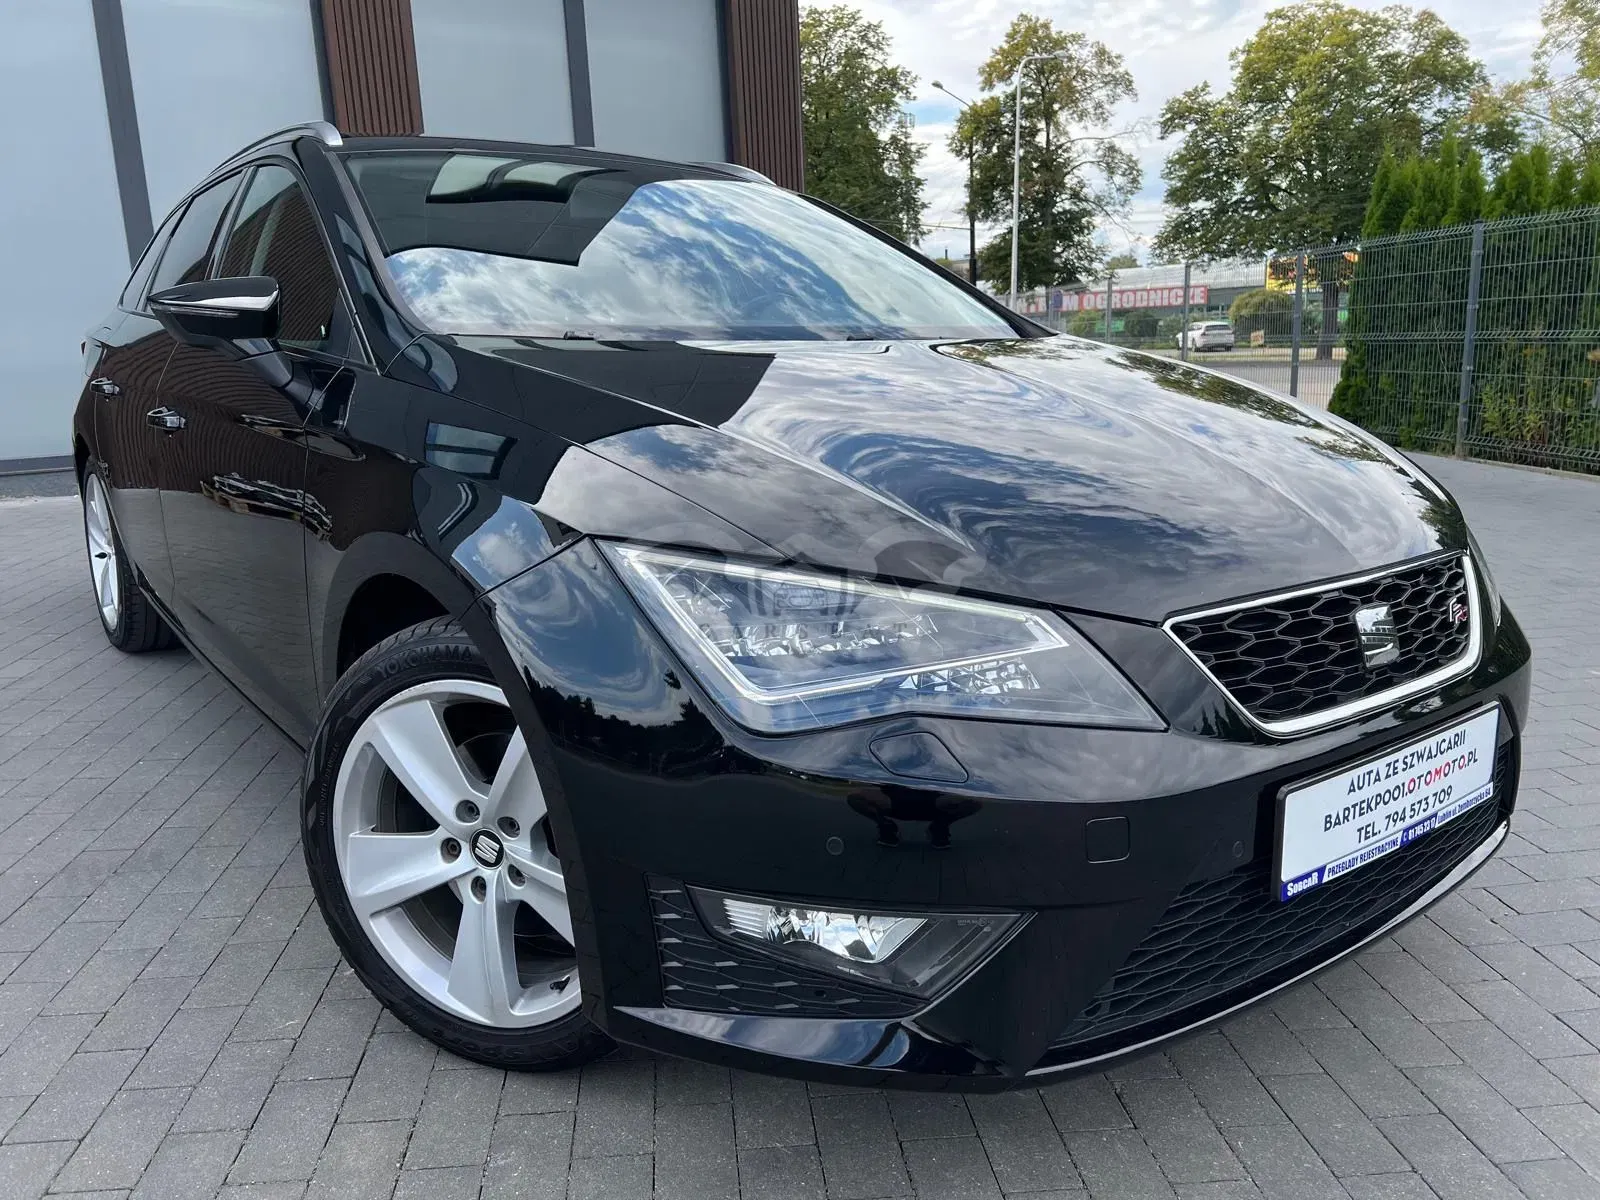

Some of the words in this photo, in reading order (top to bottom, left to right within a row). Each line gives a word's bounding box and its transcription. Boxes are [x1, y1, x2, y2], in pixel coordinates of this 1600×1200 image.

[1347, 767, 1381, 795] AUTA
[1384, 758, 1399, 780] ZE
[1402, 729, 1466, 773] SZWAJCARII
[1357, 823, 1381, 844] TEL.
[1385, 806, 1406, 831] 794
[1409, 795, 1430, 819] 573
[1432, 785, 1453, 808] 709
